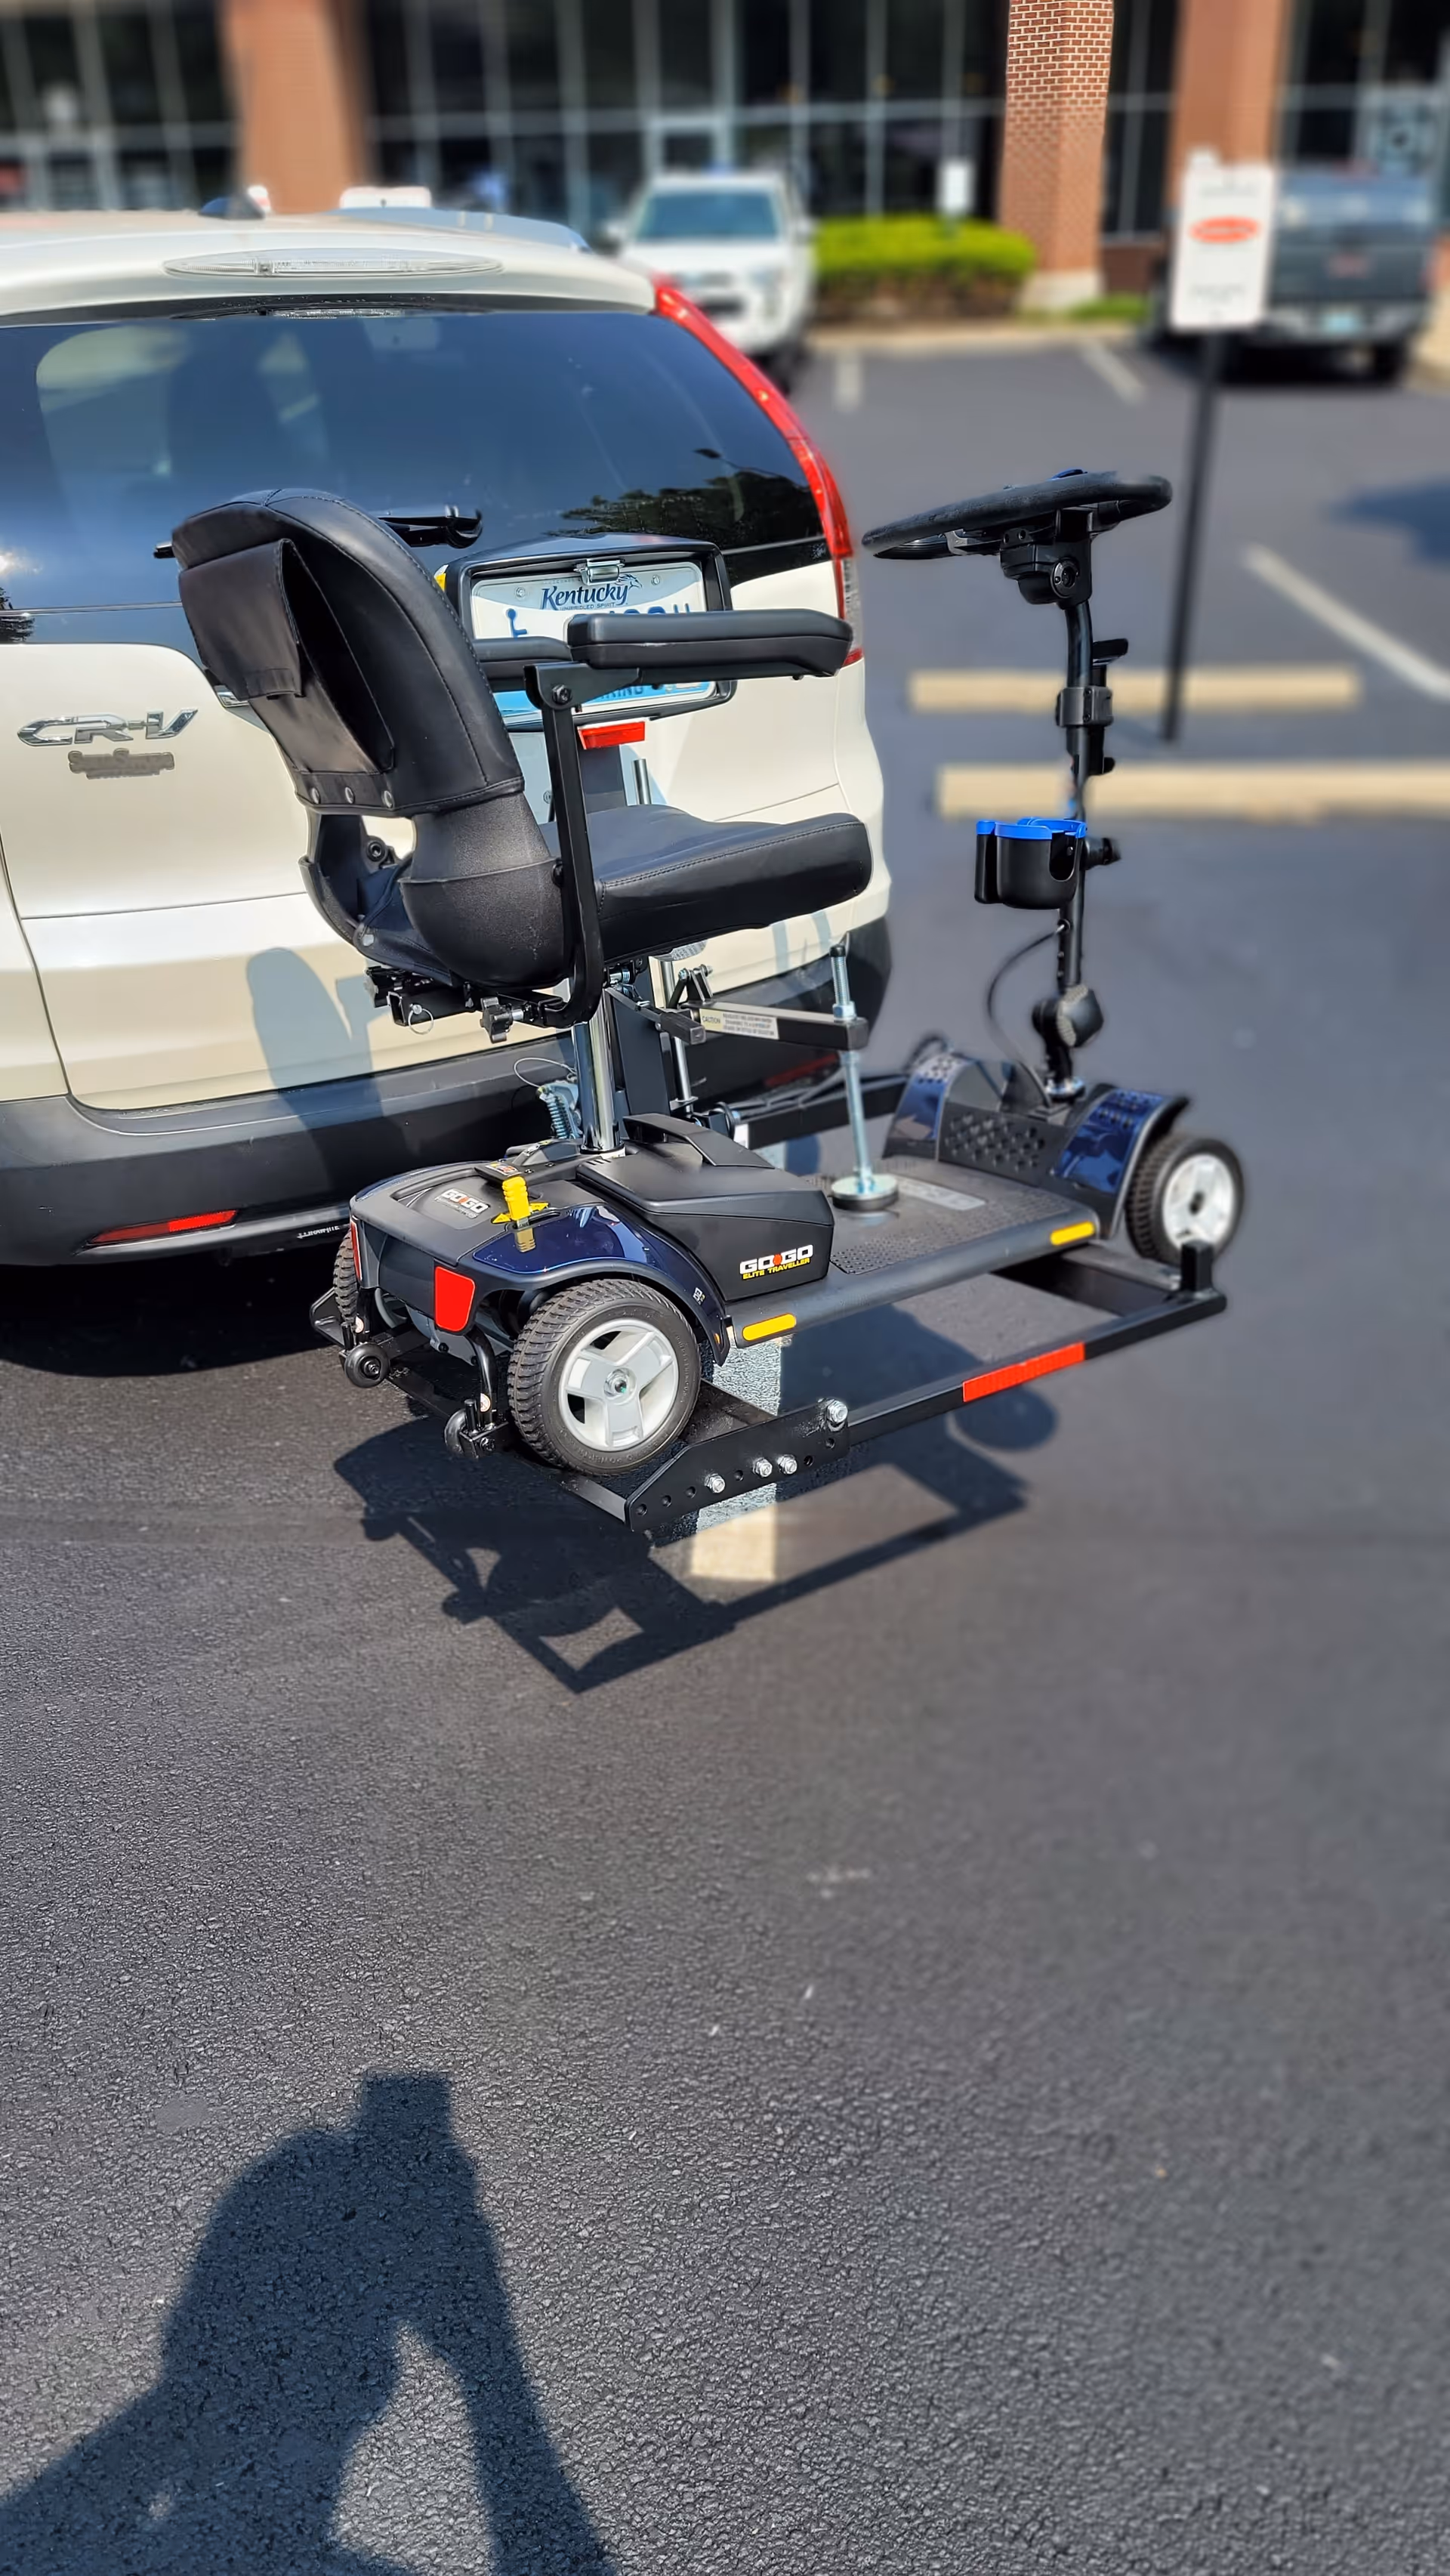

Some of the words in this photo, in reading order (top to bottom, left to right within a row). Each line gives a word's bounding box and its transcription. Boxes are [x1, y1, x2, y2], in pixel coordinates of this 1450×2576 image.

[540, 583, 628, 610] Kentucky
[17, 709, 198, 746] CR-V
[702, 1015, 720, 1024] CAUTION
[742, 1269, 765, 1280] ELITE
[767, 1257, 810, 1274] TRAVELLER
